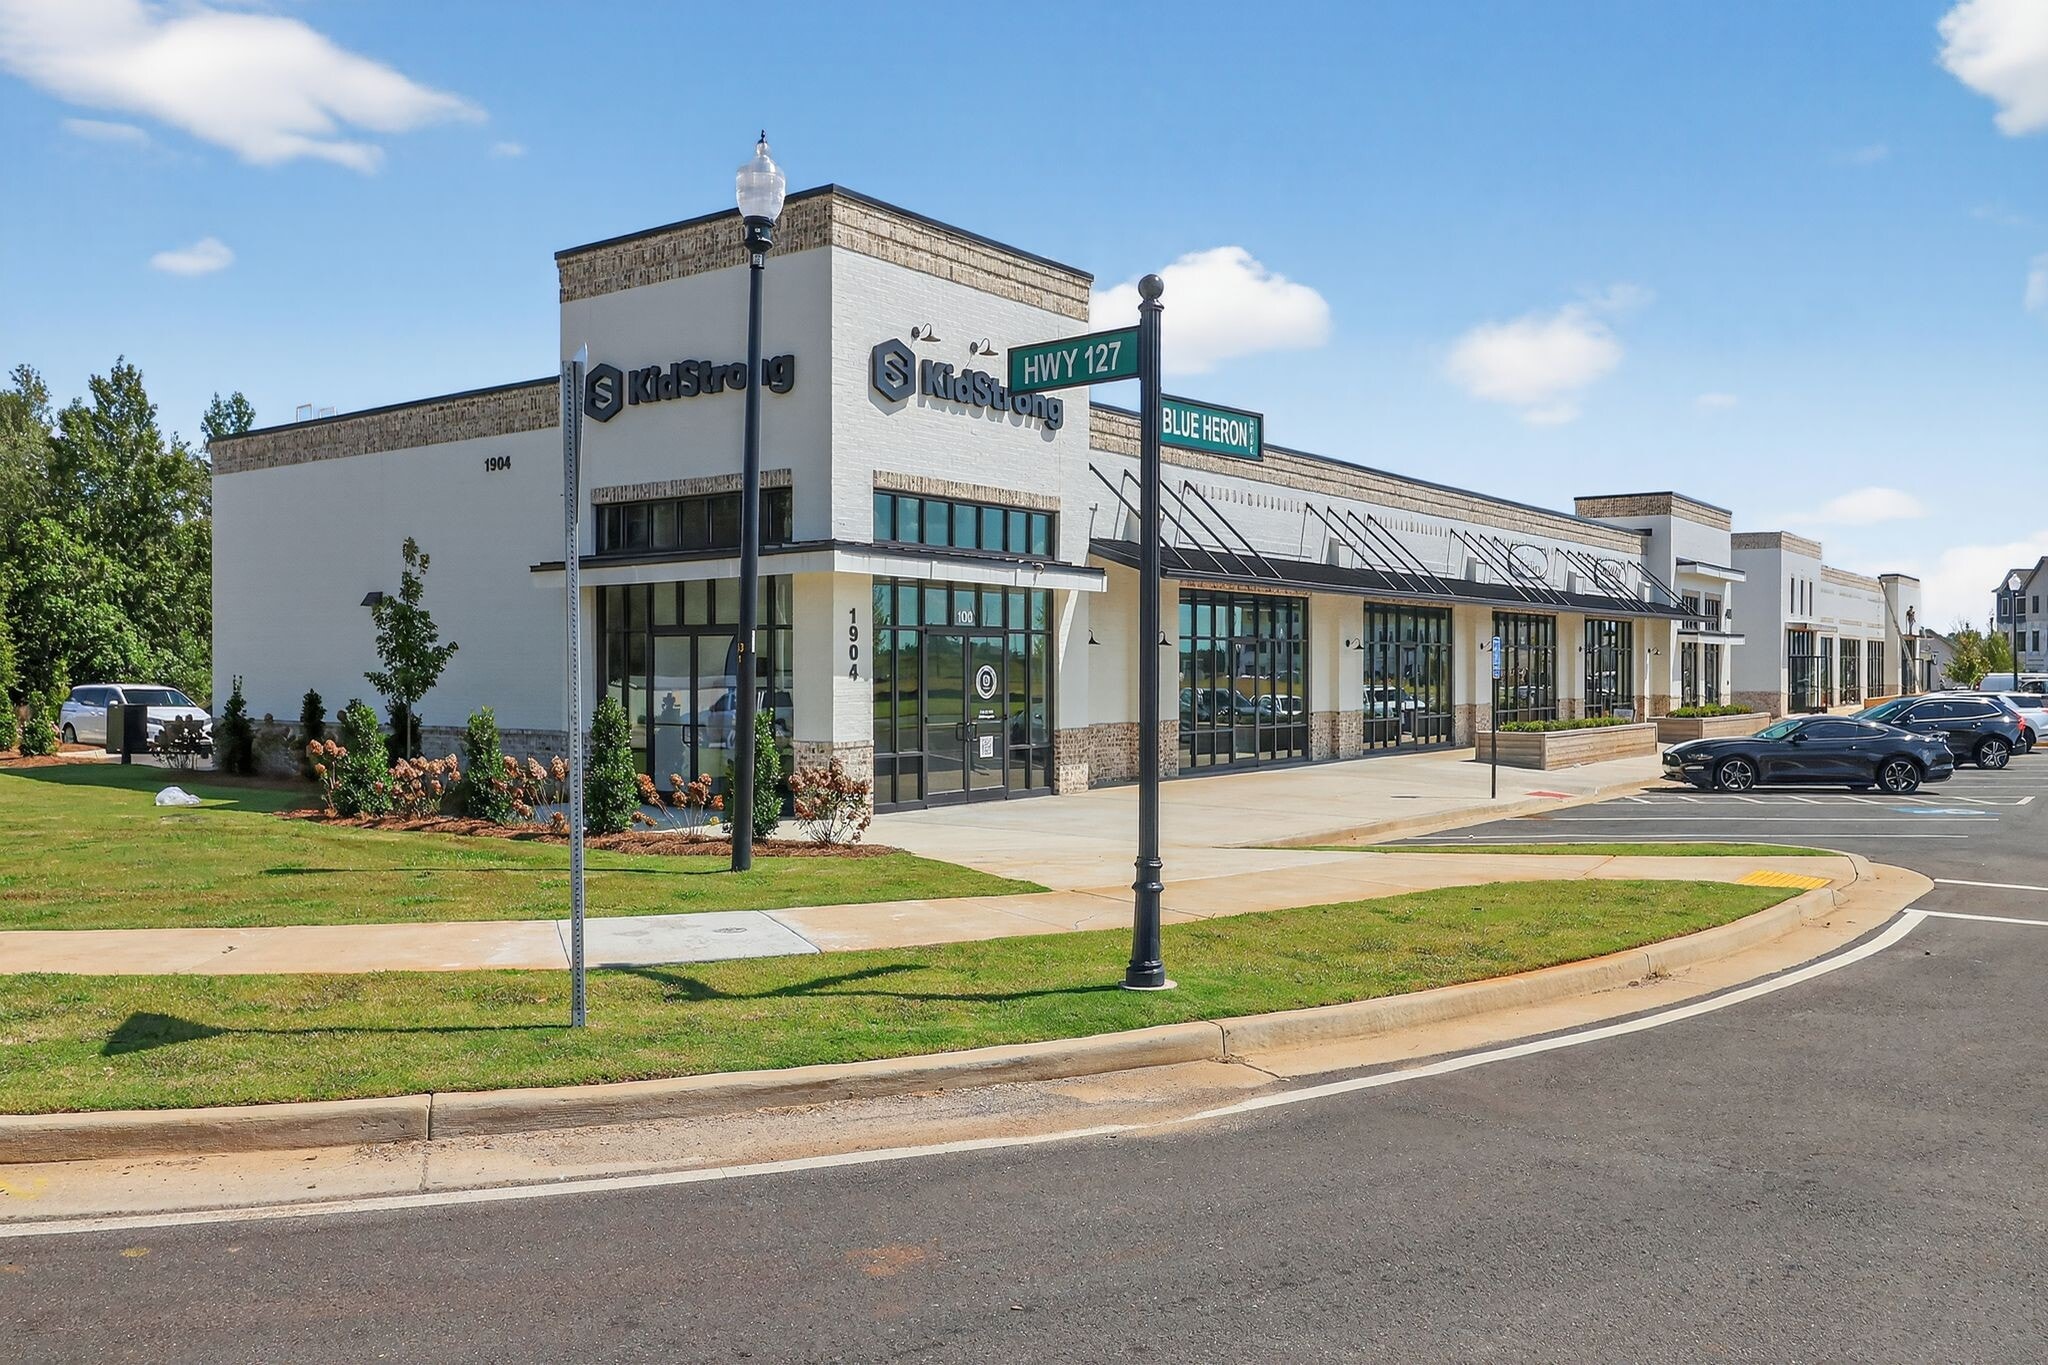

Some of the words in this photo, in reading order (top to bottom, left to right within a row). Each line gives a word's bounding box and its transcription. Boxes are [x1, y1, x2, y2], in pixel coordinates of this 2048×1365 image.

[1024, 348, 1079, 385] HWY
[1084, 341, 1122, 375] 127
[1162, 407, 1200, 438] BLUE
[1202, 414, 1248, 447] HERON
[484, 455, 512, 472] 1904
[957, 610, 973, 623] 100
[848, 607, 860, 681] 1904
